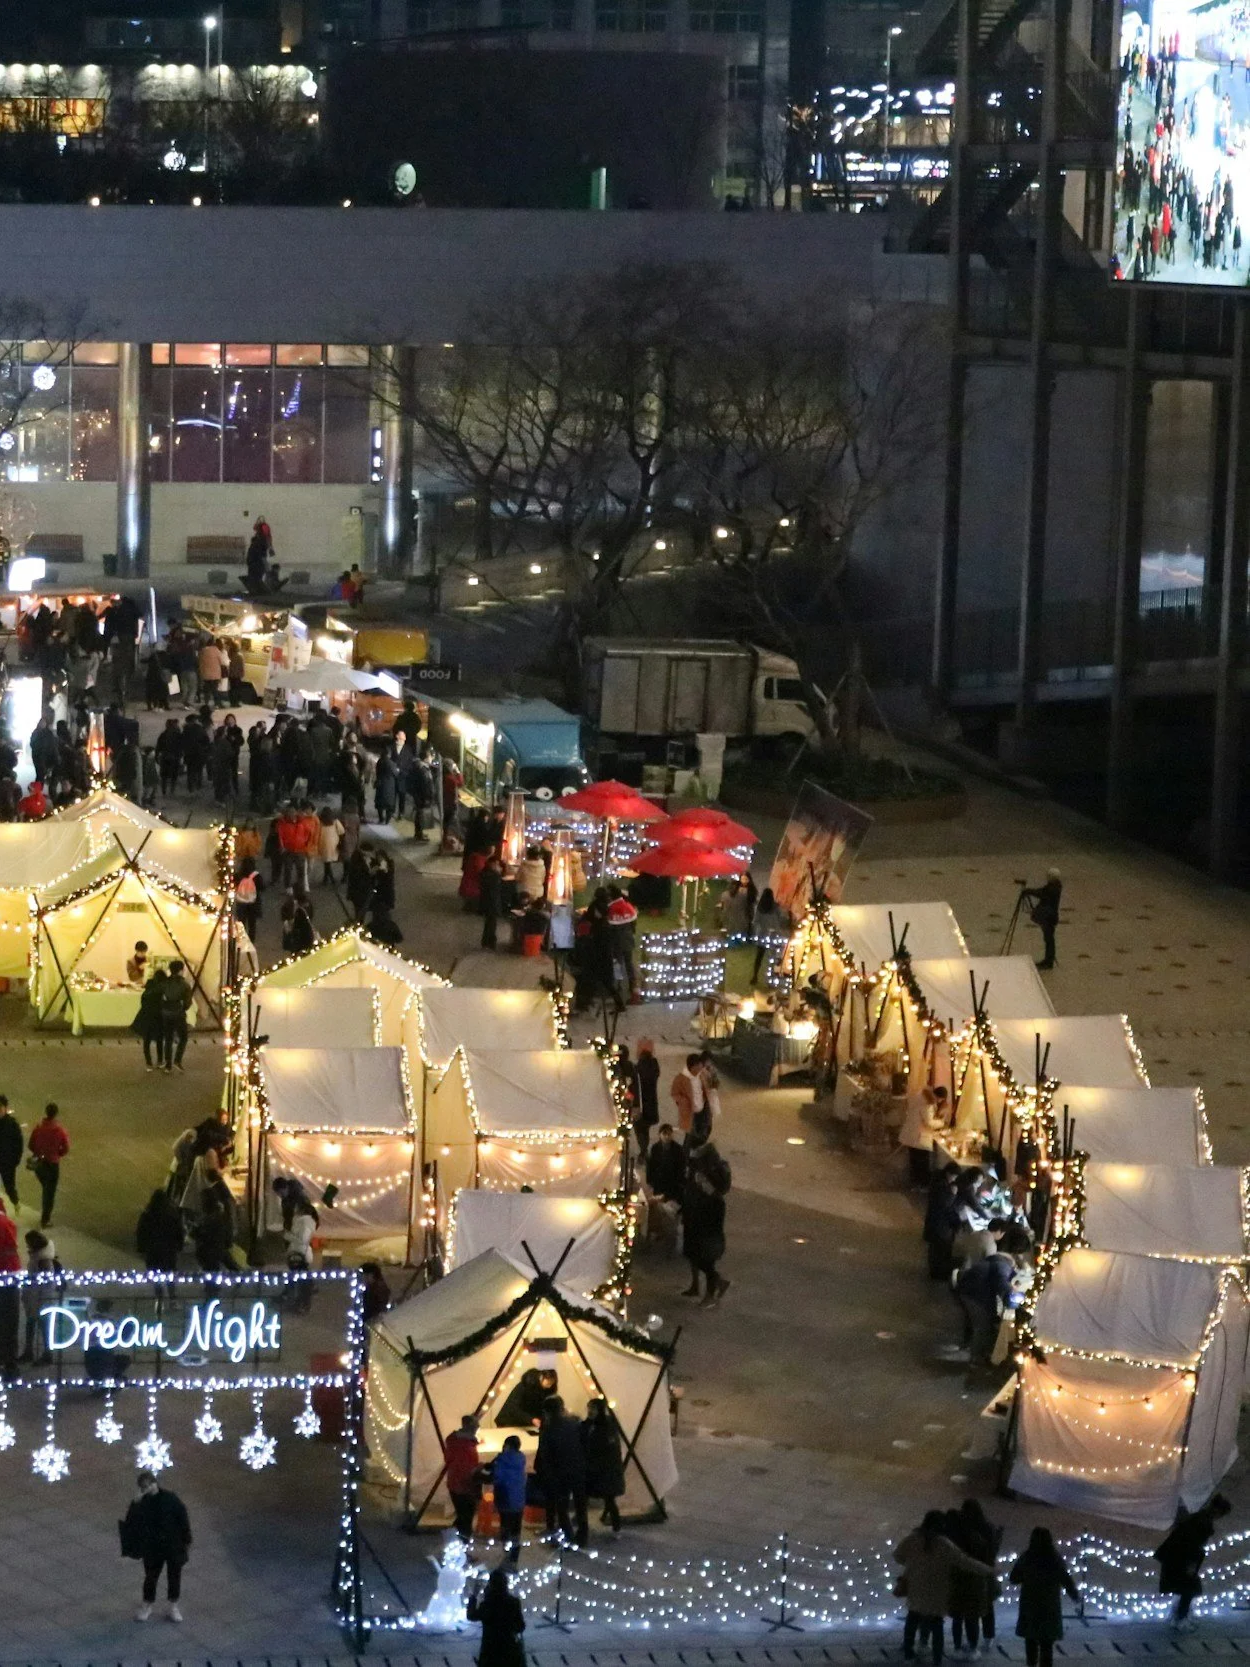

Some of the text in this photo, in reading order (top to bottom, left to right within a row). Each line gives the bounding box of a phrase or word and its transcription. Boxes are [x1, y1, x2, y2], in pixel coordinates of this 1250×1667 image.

[419, 669, 451, 680] FOOD
[39, 1299, 282, 1363] Dream Night
